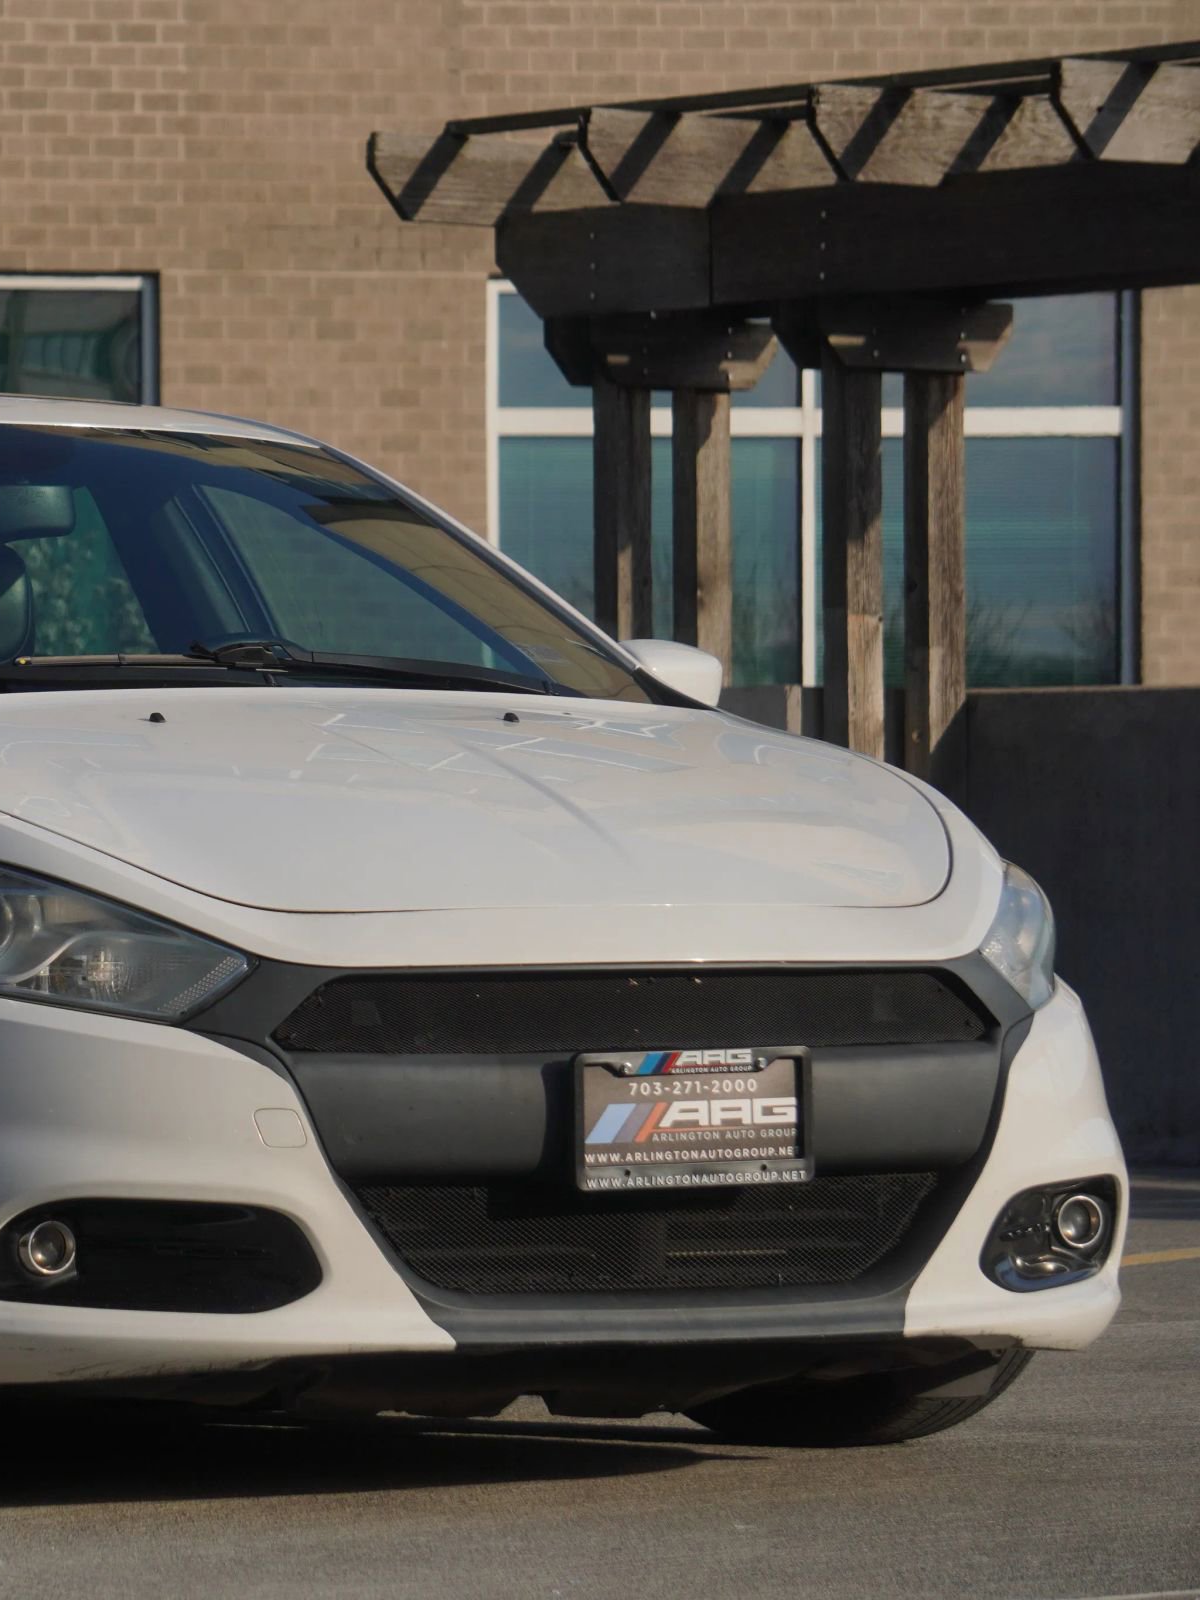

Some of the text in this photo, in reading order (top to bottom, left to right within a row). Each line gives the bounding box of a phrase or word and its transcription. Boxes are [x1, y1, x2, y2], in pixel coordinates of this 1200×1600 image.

[675, 1049, 751, 1066] AAG
[629, 1079, 757, 1096] 703-271-2000
[659, 1098, 796, 1127] AAG
[652, 1127, 798, 1142] ARLINGTON AUTO GROUP
[587, 1170, 806, 1188] WWW.ARLINGTONAUTOGROUP.NET
